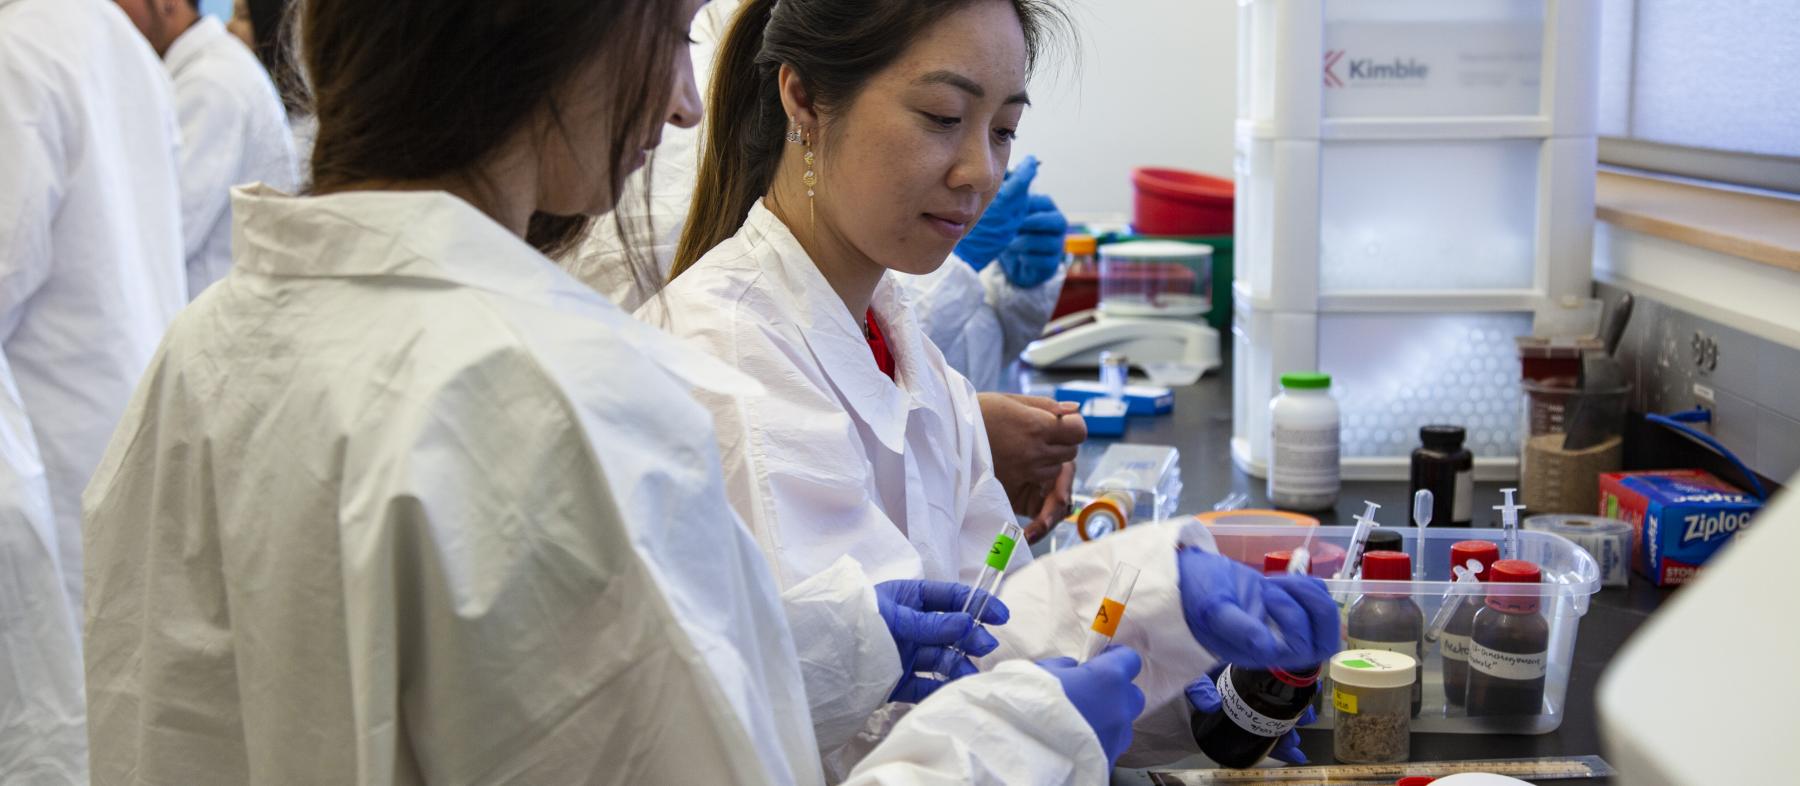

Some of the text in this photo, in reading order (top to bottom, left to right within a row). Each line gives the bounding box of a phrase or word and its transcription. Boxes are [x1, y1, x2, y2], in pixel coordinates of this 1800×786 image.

[1349, 59, 1428, 80] Kimble
[1684, 511, 1750, 542] Ziploc
[1095, 604, 1109, 624] A
